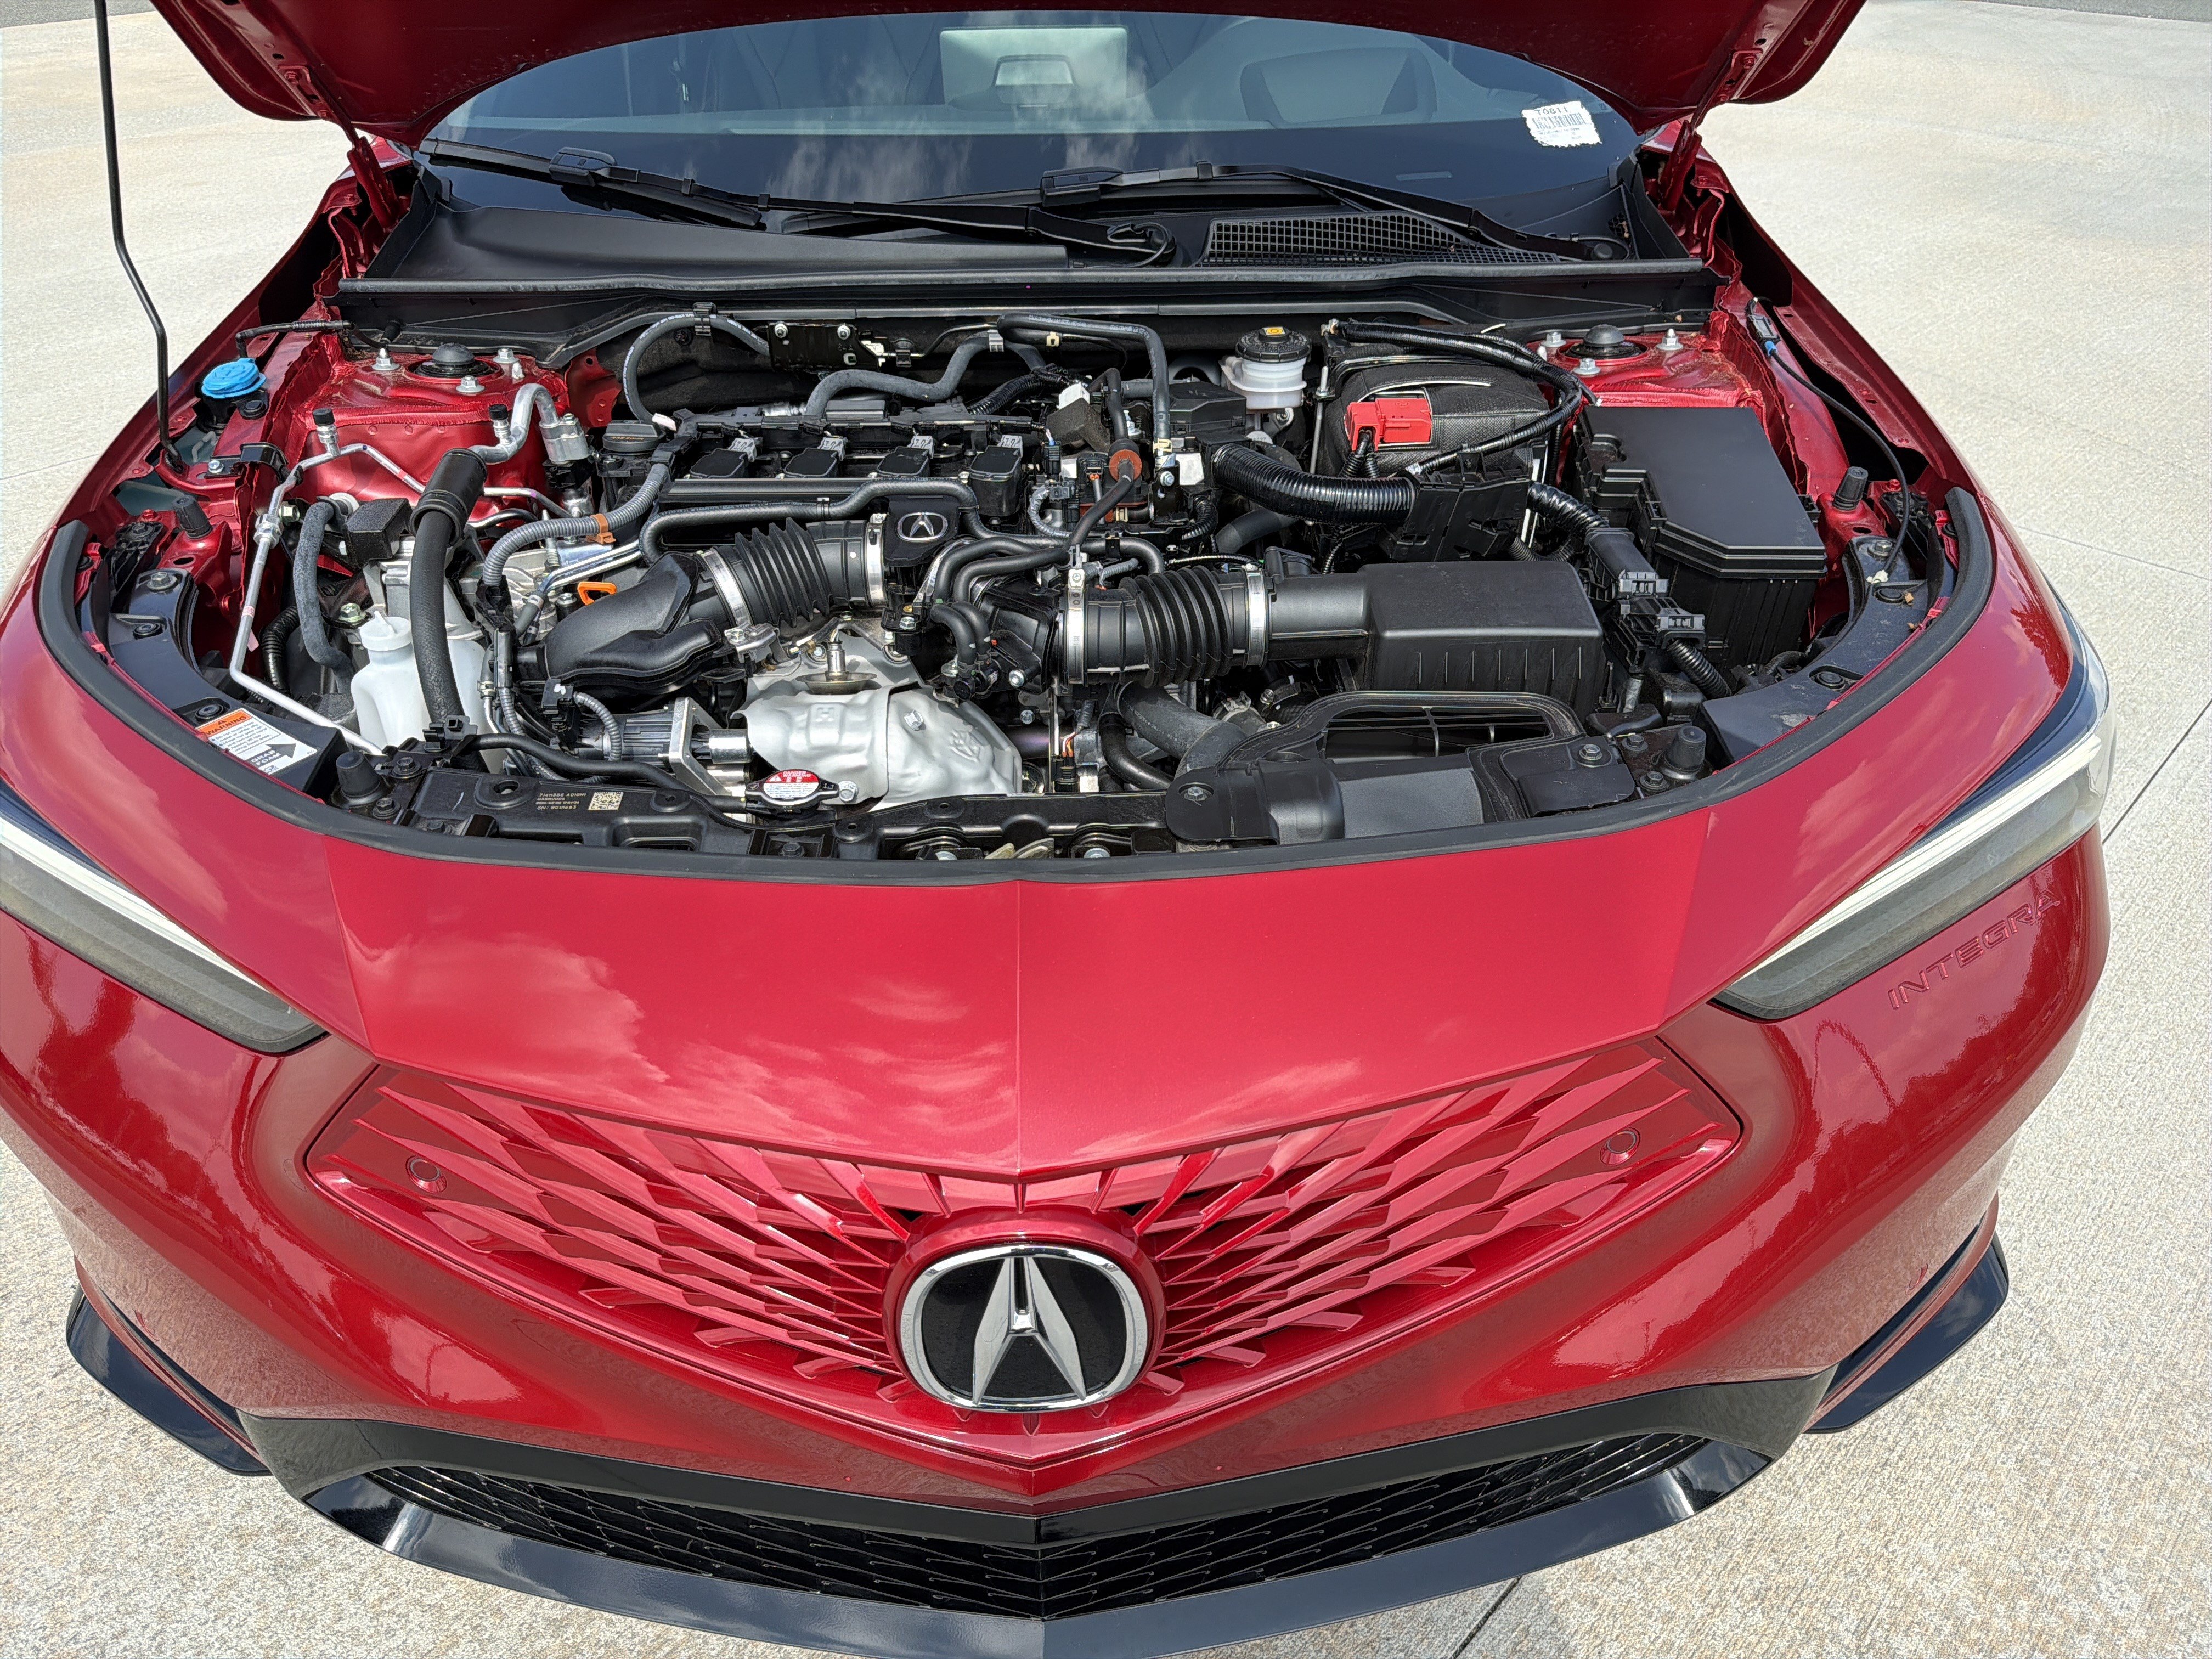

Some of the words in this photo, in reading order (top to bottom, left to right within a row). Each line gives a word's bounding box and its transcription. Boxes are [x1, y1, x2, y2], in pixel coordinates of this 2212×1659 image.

[205, 716, 247, 735] WARNING
[251, 750, 276, 763] GRAB
[256, 752, 281, 766] FOAM
[1887, 890, 2061, 1010] INTEGRA
